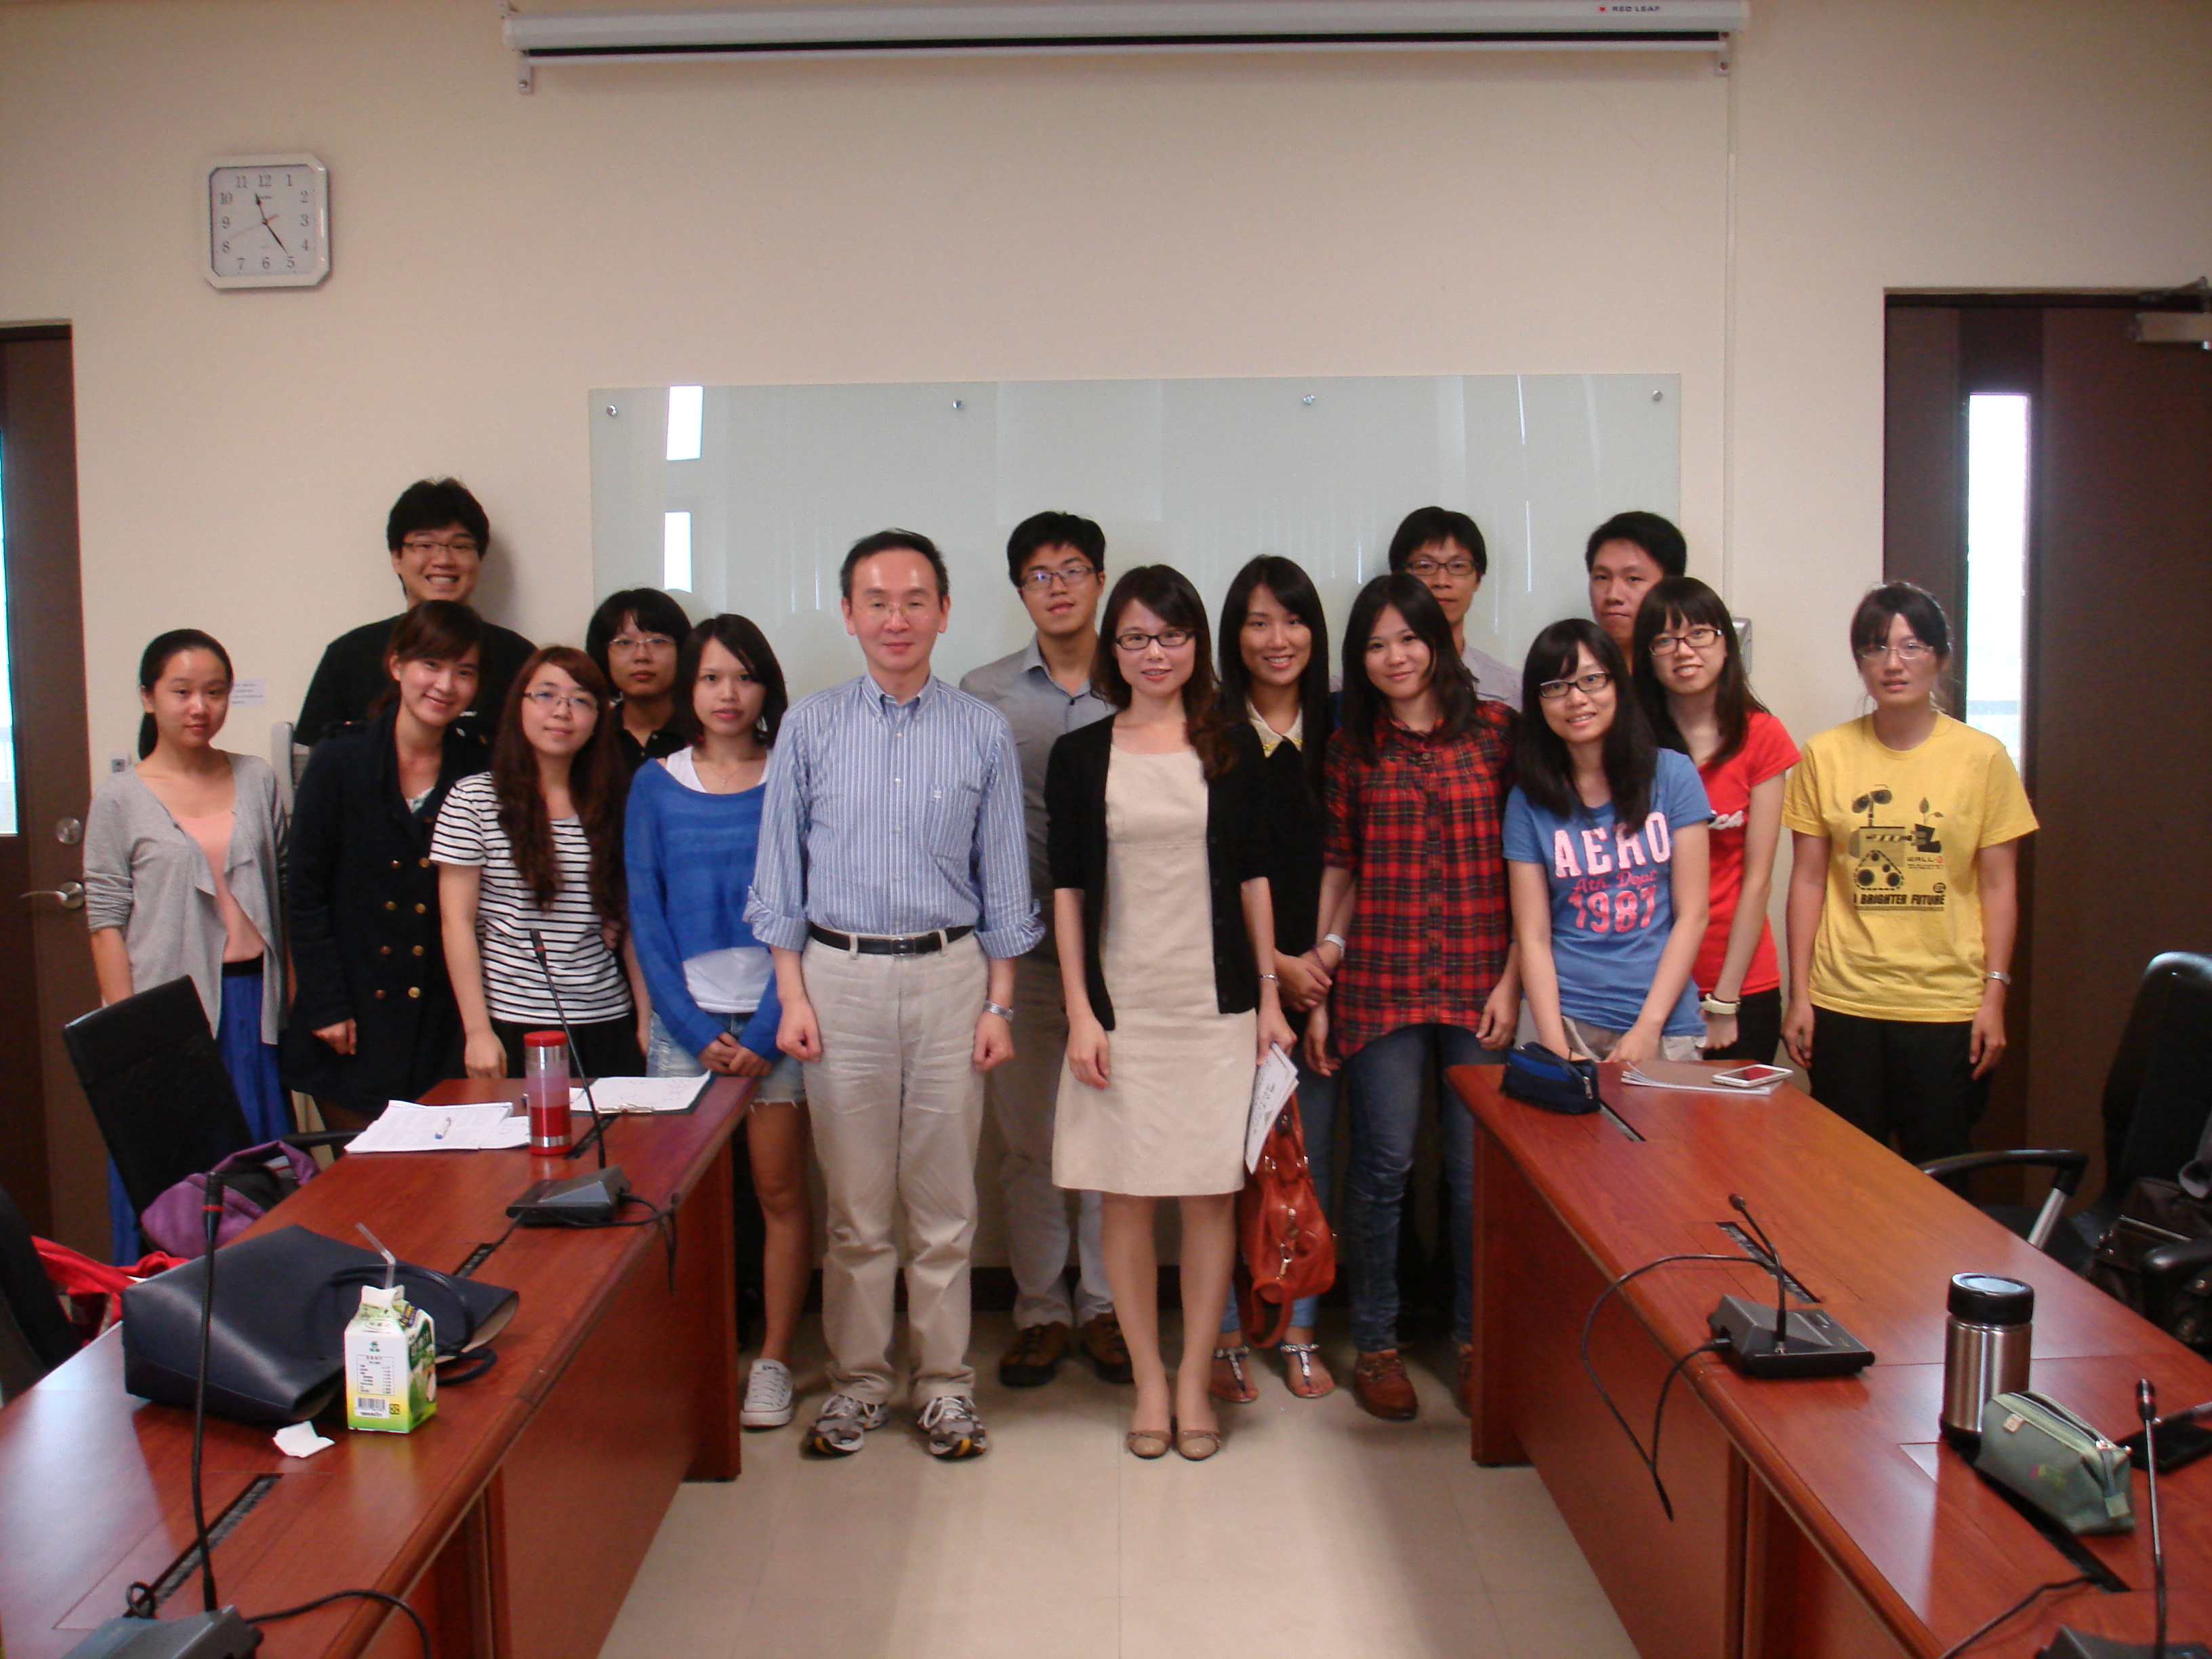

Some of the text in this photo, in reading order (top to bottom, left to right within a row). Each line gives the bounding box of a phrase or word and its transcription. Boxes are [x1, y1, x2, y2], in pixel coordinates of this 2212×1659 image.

[236, 175, 248, 188] 11
[258, 173, 272, 188] 12
[286, 173, 293, 187] 1
[220, 192, 233, 205] 10
[300, 190, 308, 203] 2
[221, 216, 230, 230] 9
[300, 213, 309, 227] 3
[221, 241, 230, 254] 8
[300, 239, 310, 251] 4
[237, 257, 246, 270] 7
[262, 256, 270, 270] 6
[287, 255, 295, 269] 5
[1554, 811, 1672, 878] AERO
[1616, 869, 1658, 891] Dept
[1860, 893, 1908, 905] BRIGHTER
[1911, 894, 1946, 905] FUTURE
[1568, 884, 1657, 933] 1987
